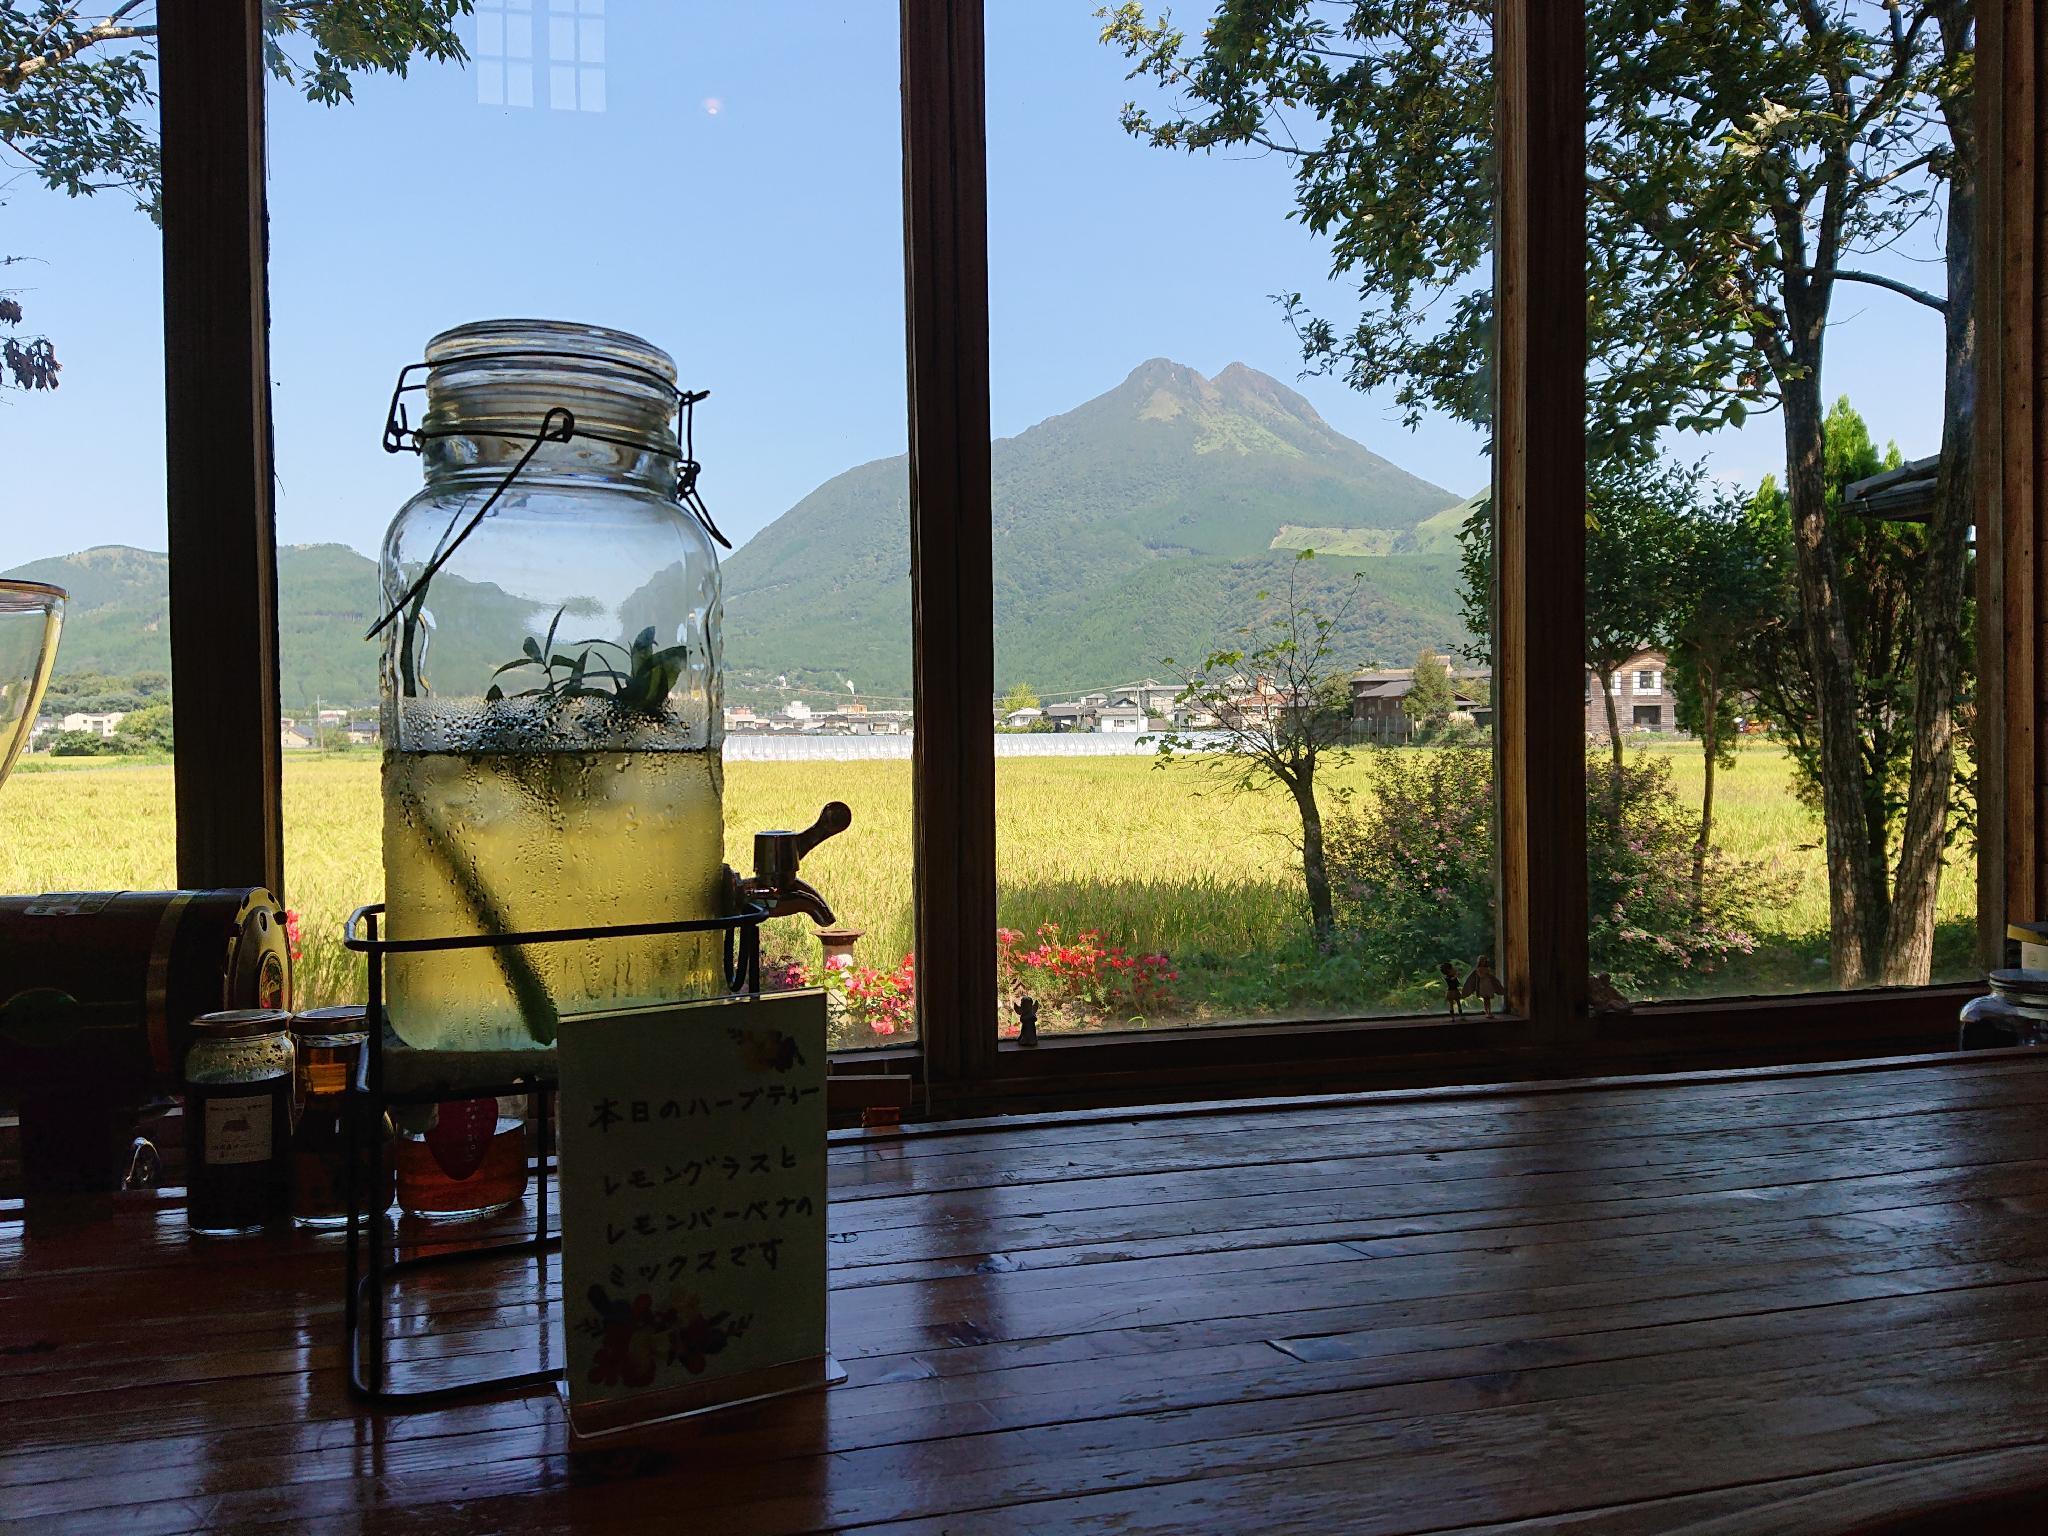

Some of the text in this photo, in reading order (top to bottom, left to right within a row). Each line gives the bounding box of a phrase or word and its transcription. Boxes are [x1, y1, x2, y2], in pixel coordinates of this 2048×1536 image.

[604, 1145, 797, 1195] レモングラスと
[607, 1196, 814, 1245] レモンバーベナの
[609, 1238, 784, 1288] ミックスです
